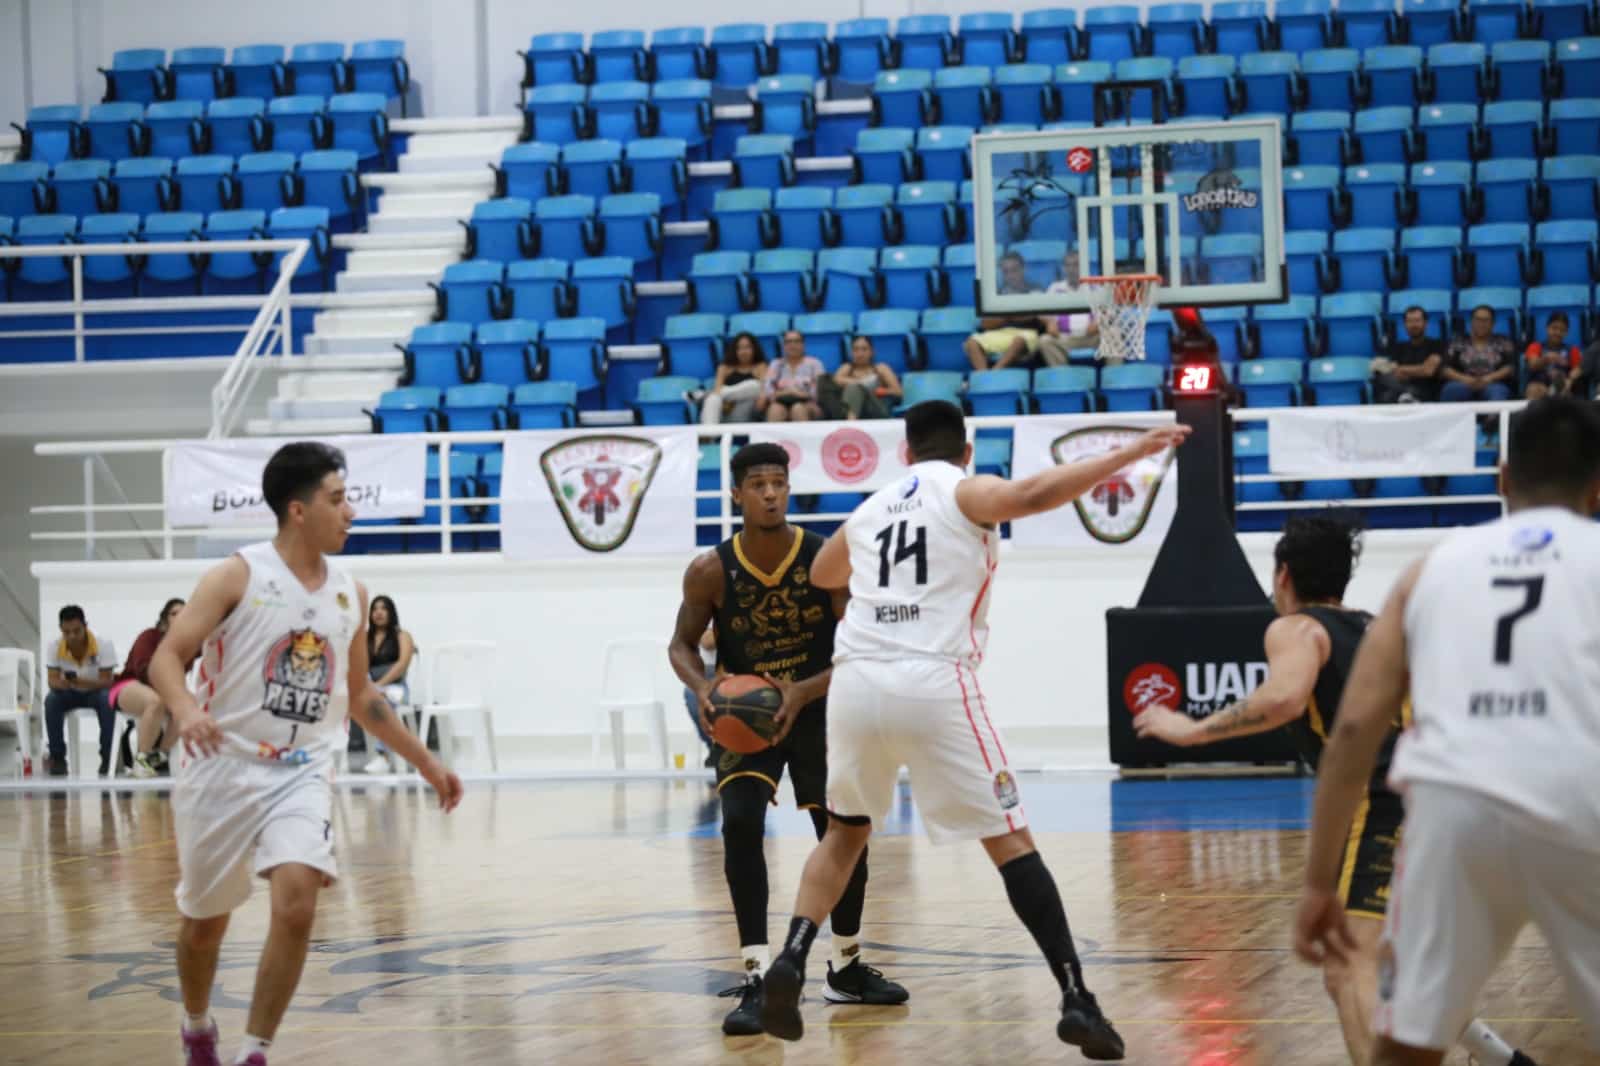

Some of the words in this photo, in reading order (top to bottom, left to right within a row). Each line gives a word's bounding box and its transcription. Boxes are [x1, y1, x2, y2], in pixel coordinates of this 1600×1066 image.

[1180, 366, 1210, 390] 20
[874, 520, 929, 588] 14
[1491, 572, 1546, 666] 7
[264, 682, 329, 720] REYES
